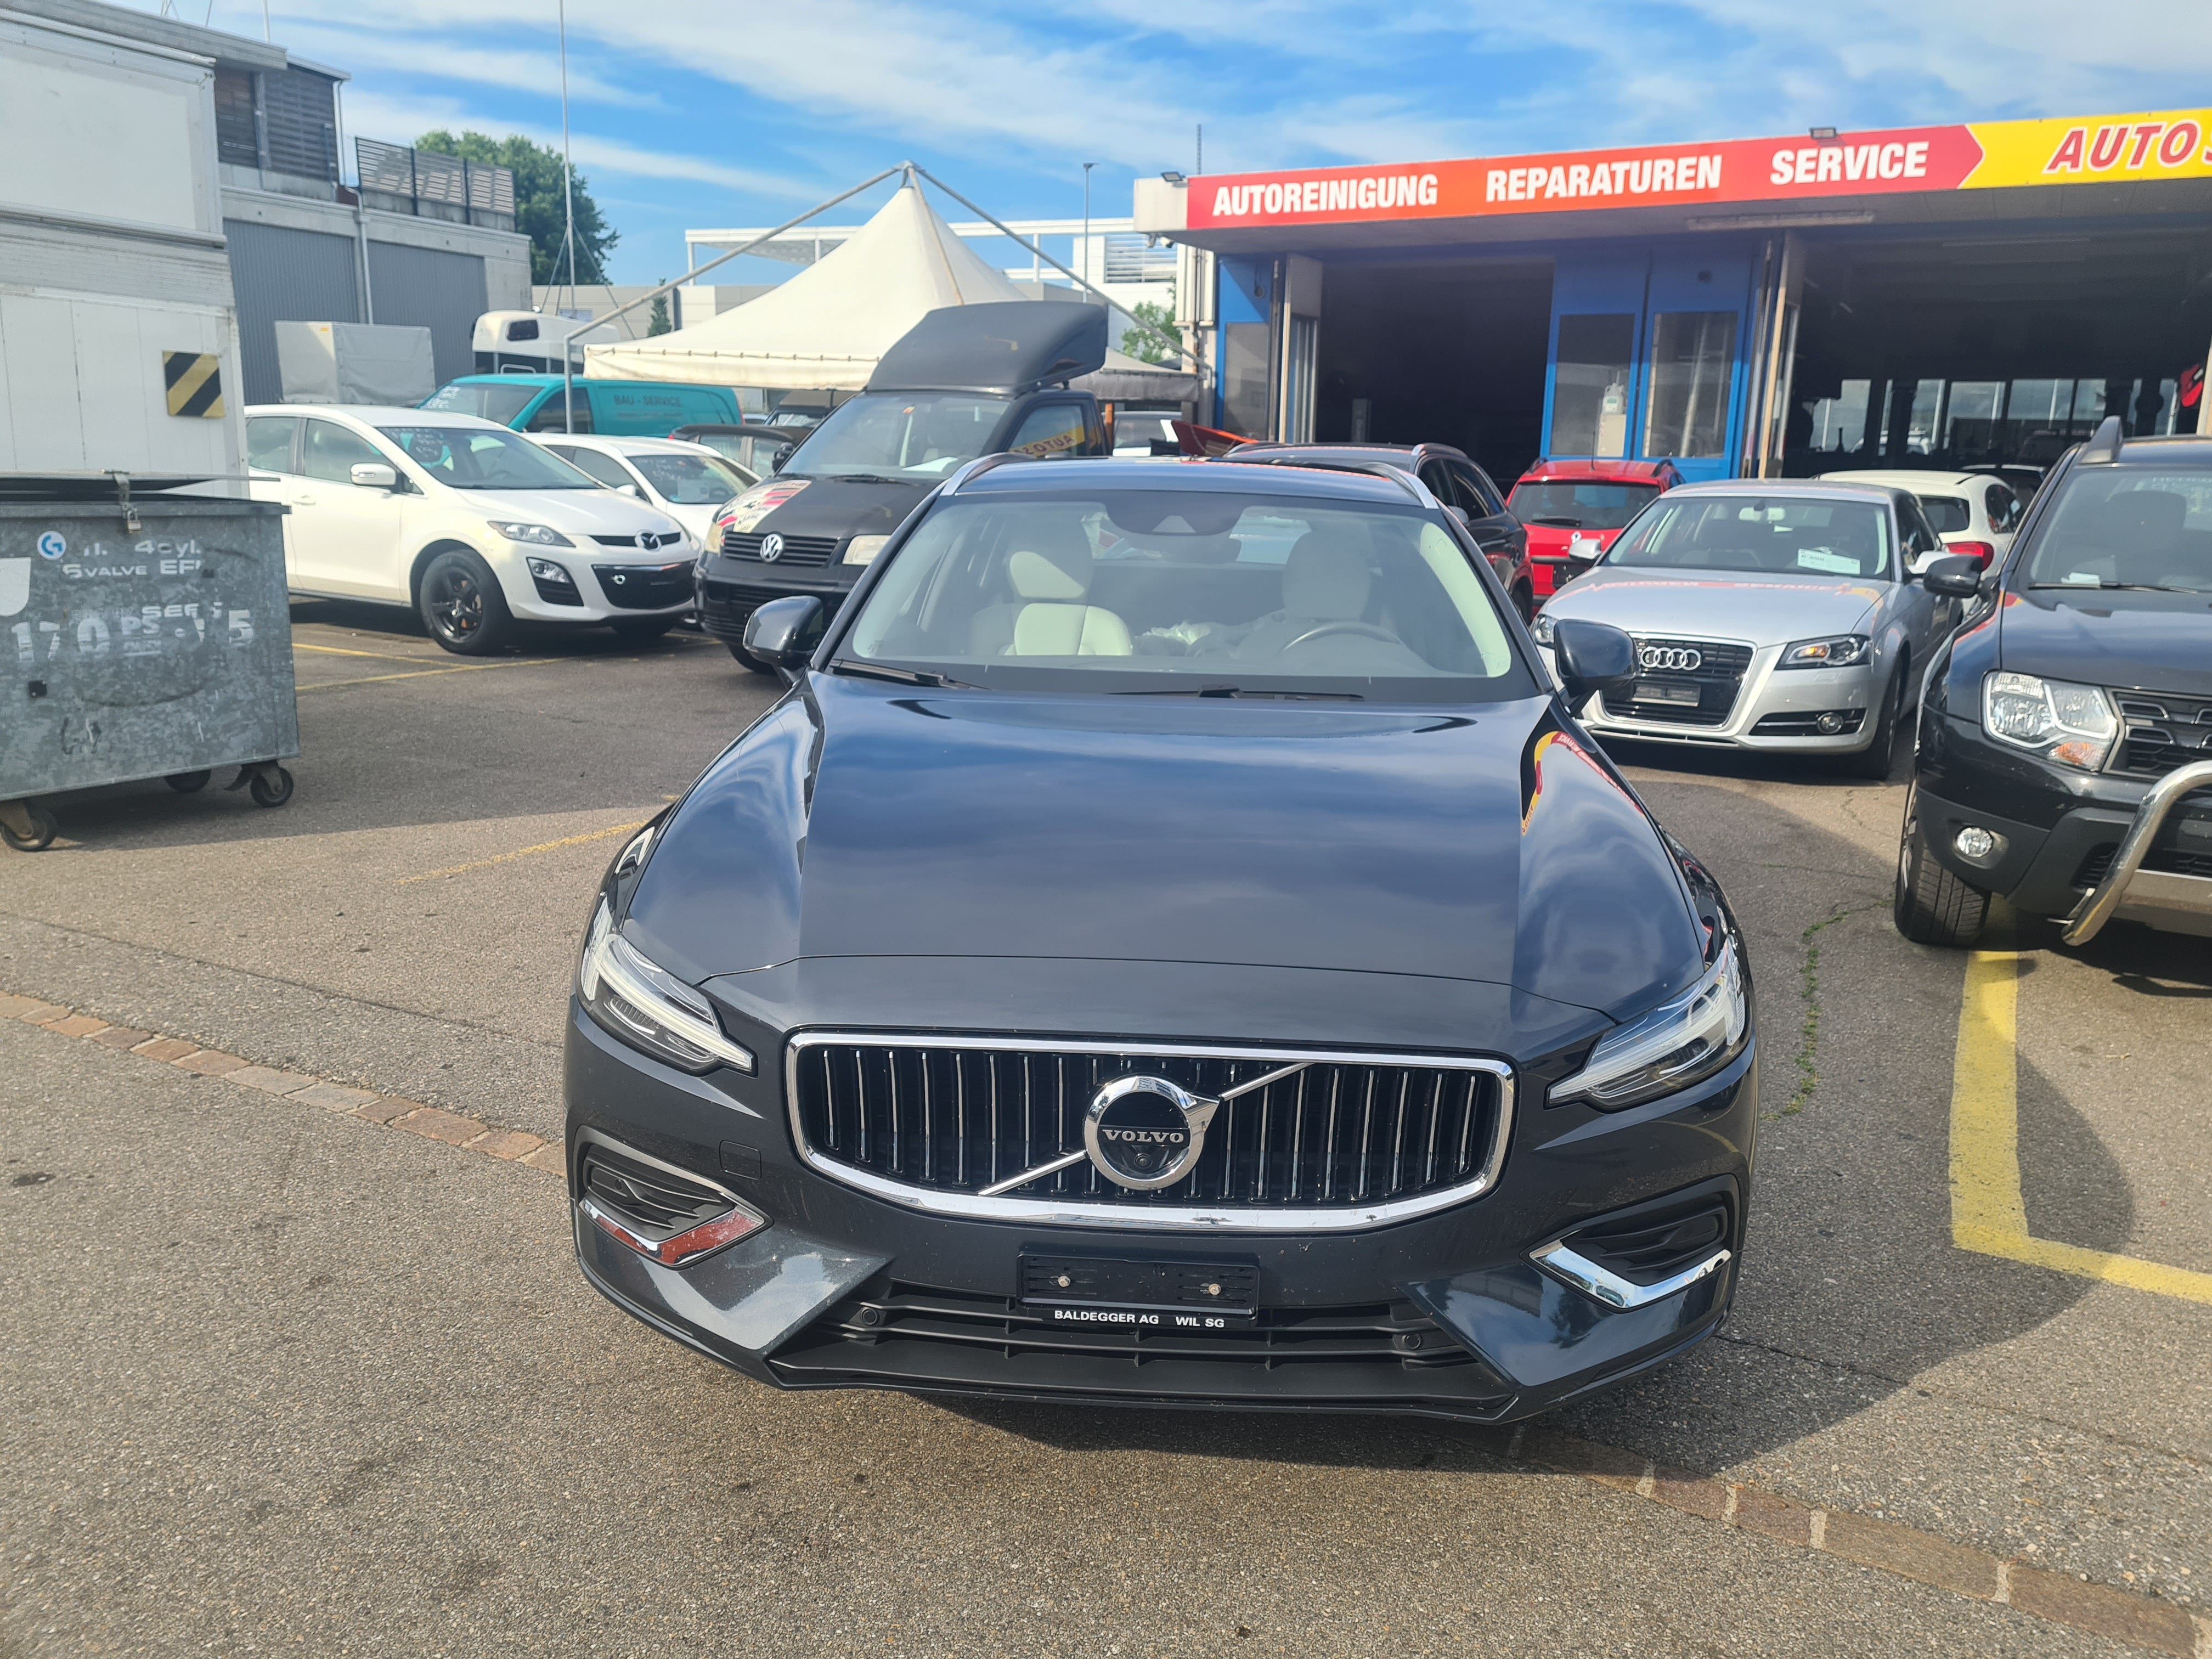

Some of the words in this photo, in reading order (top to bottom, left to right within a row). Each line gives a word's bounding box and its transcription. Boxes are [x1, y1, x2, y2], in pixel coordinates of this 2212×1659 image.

[2043, 120, 2200, 174] AUTO
[1212, 173, 1438, 217] AUTOREINIGUNG
[1486, 154, 1723, 202] REPARATUREN
[1770, 141, 1929, 185] SERVICE
[613, 394, 635, 406] BAU
[1102, 1129, 1184, 1143] VOLVO
[1054, 1310, 1136, 1323] BALDEGGER
[1138, 1313, 1159, 1324] AG
[1176, 1316, 1200, 1327] WIL
[1205, 1318, 1225, 1328] SG
